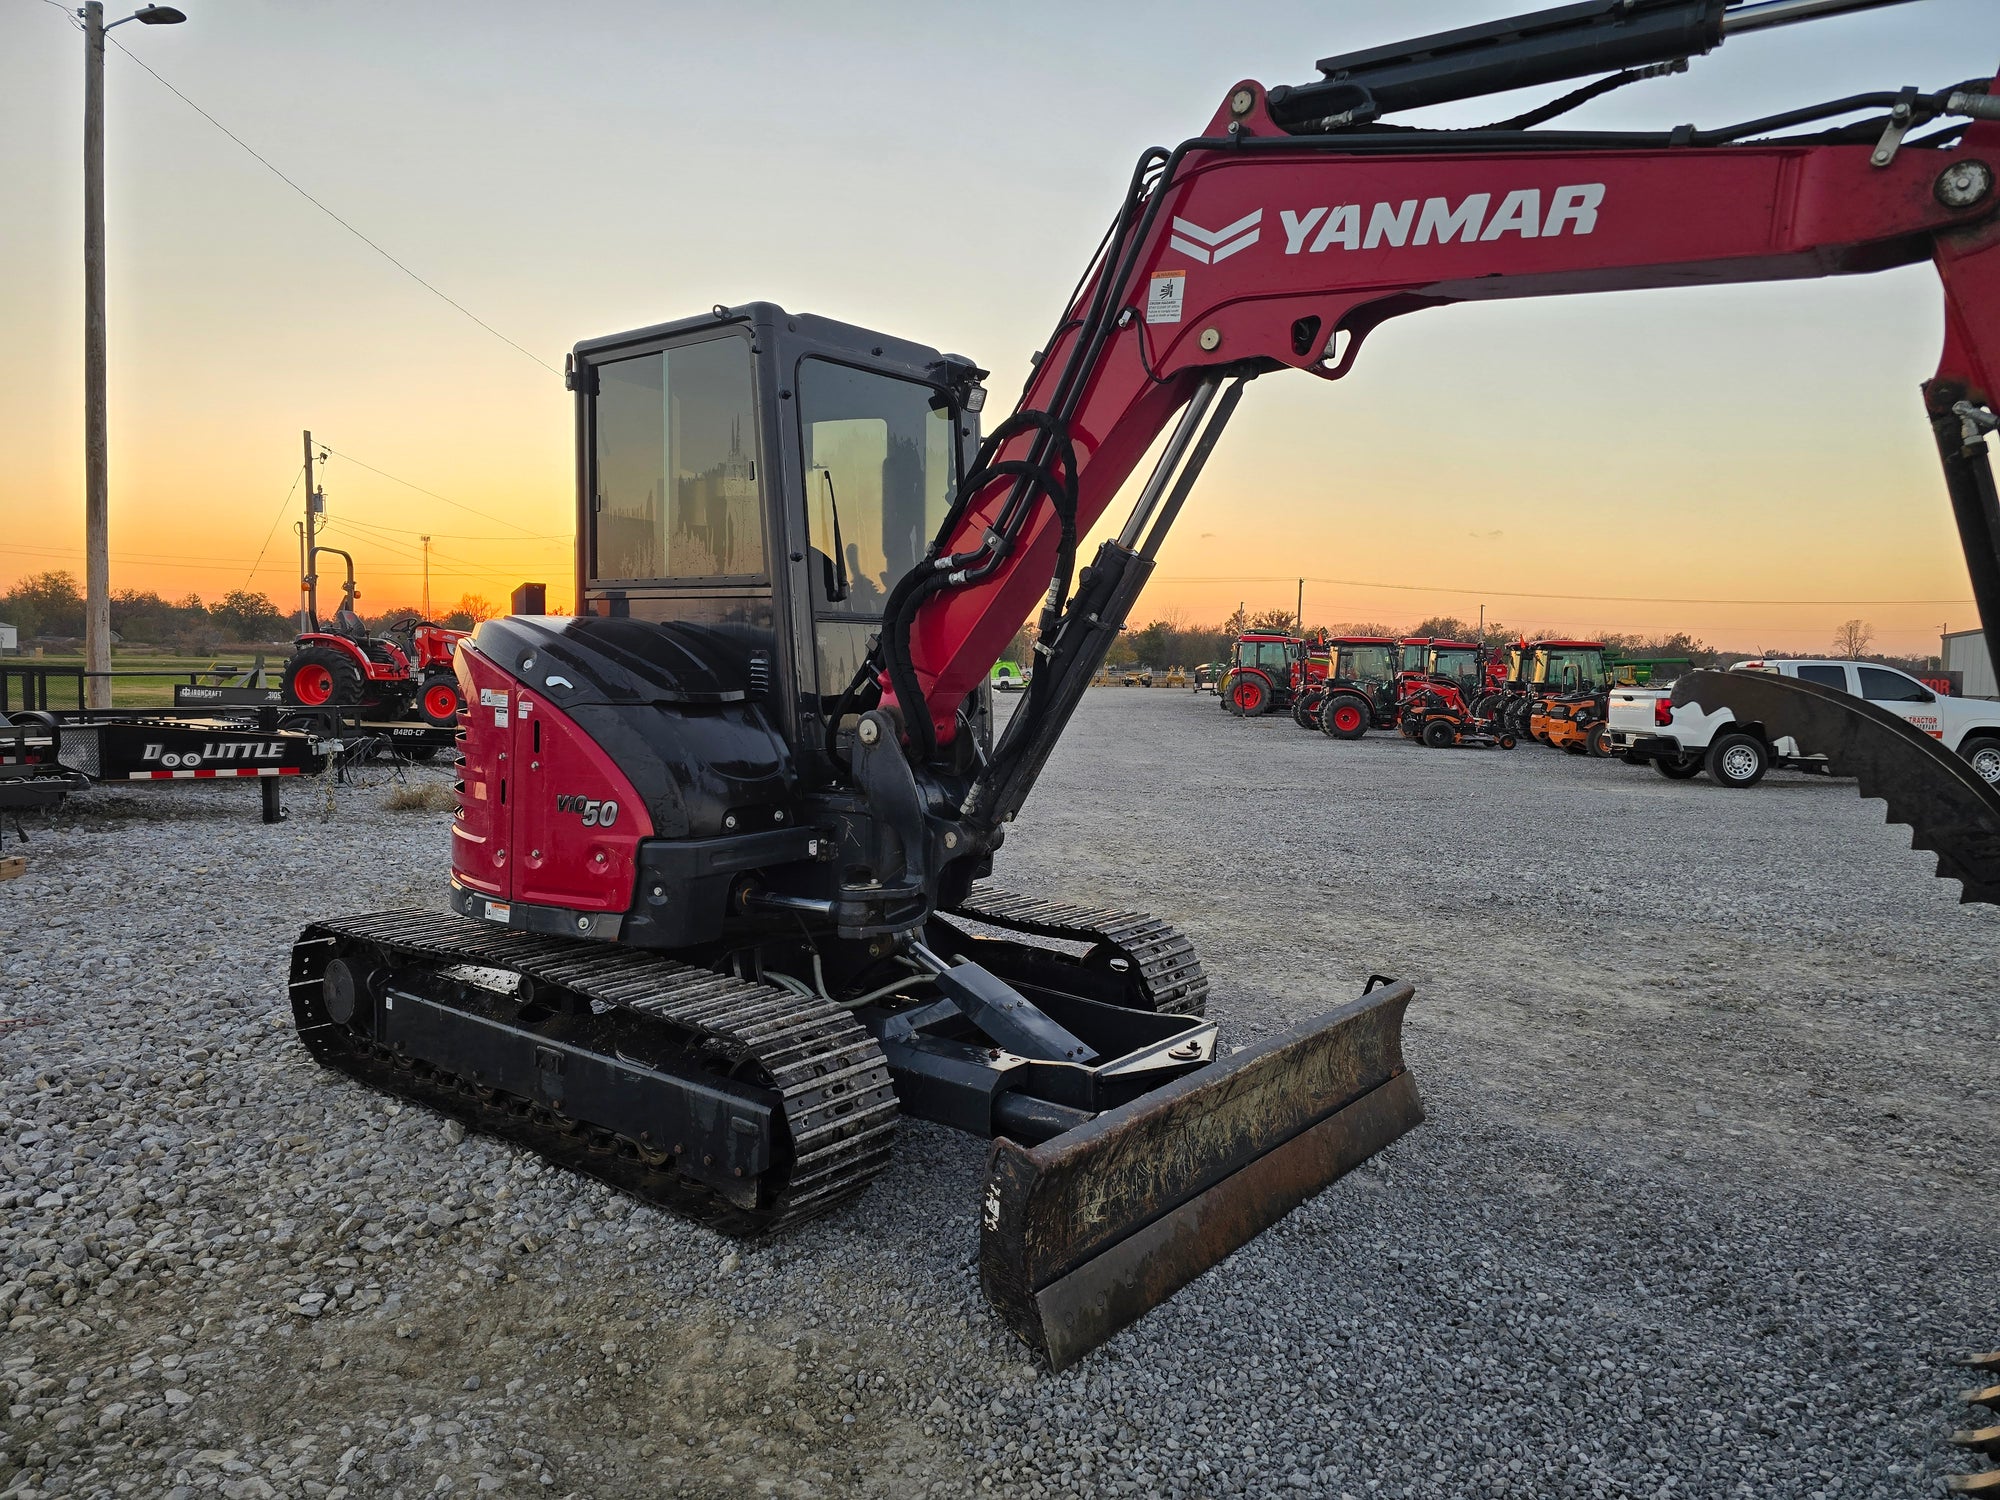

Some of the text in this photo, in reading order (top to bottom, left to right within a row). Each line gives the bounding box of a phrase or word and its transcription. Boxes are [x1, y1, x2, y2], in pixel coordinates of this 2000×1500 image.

[1280, 183, 1606, 255] YANMAR
[191, 689, 222, 698] IRONCRAFT
[393, 728, 425, 736] 8420-CF
